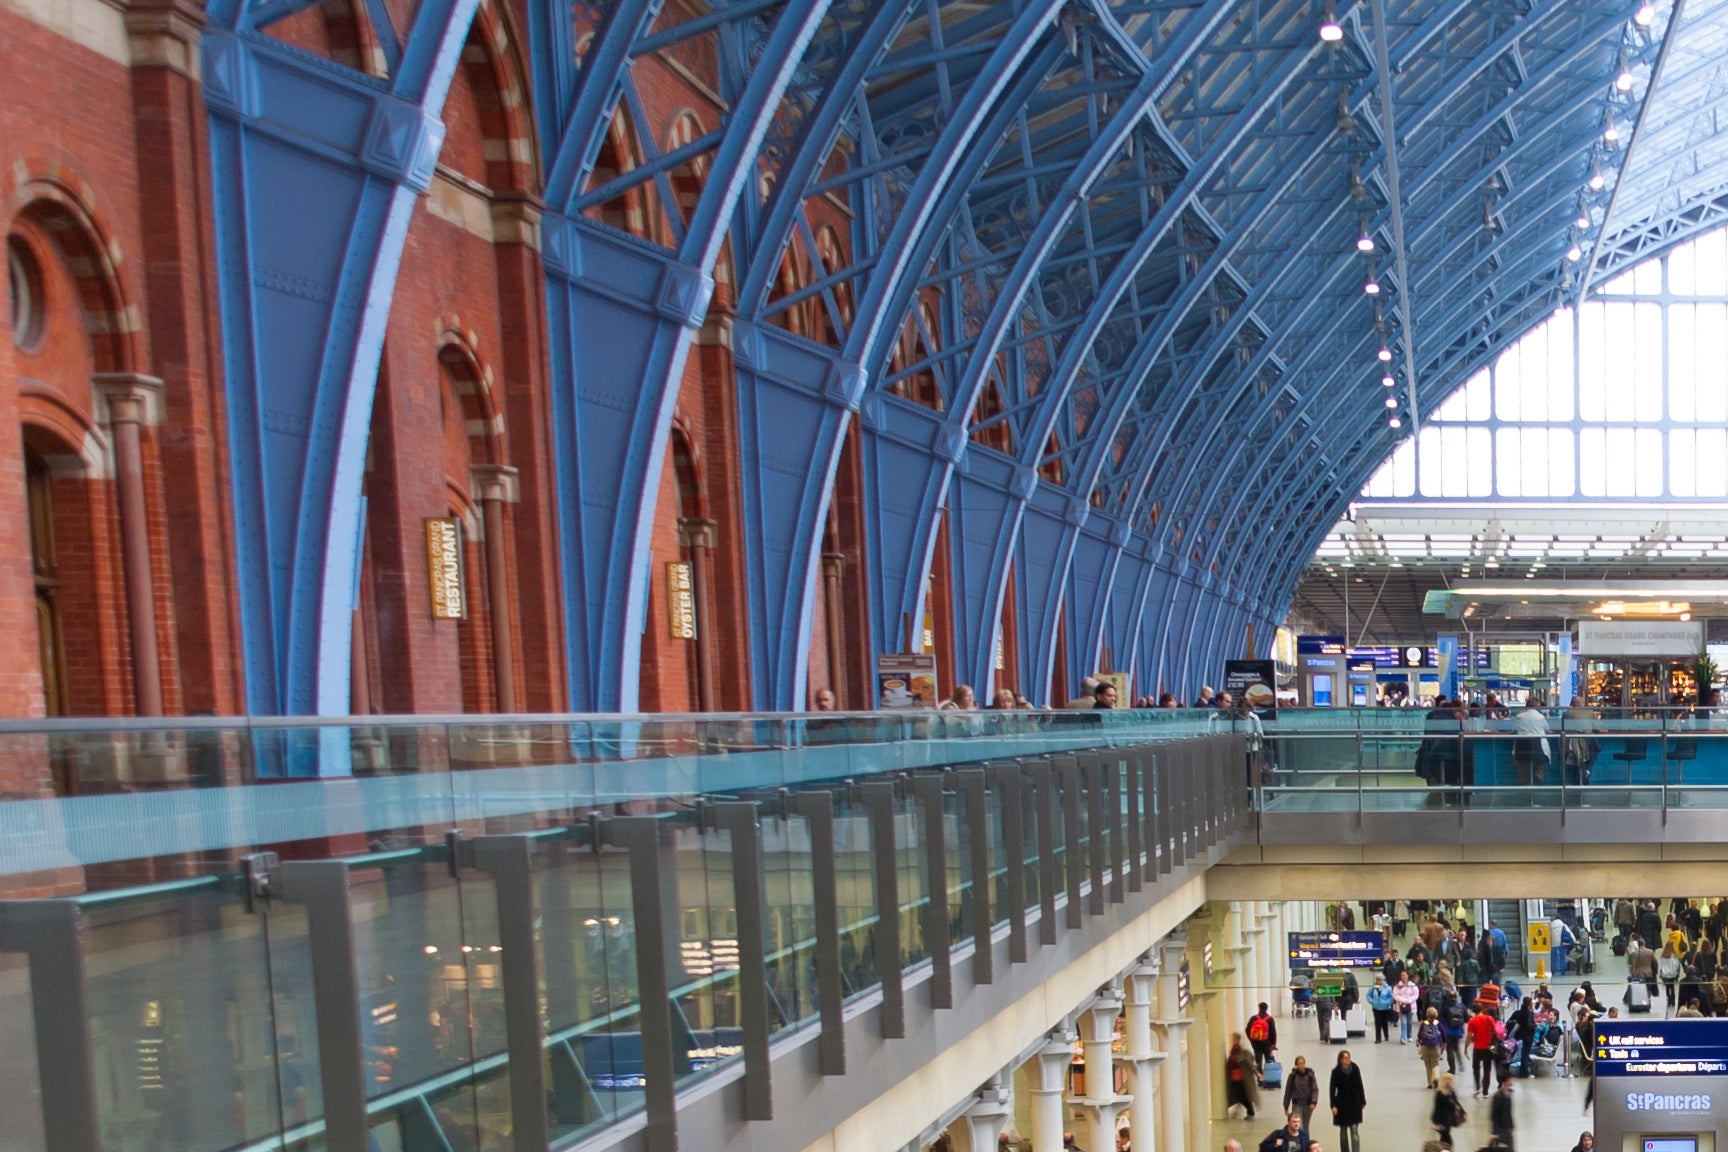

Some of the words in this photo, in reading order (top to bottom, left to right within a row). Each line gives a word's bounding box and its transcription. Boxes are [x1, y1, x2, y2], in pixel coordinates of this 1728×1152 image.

[430, 521, 442, 557] GRAND
[432, 558, 447, 603] PANCRAS
[440, 522, 461, 618] RESTAURANT
[677, 564, 691, 589] BAR
[679, 592, 693, 638] OYSTER
[1609, 1036, 1621, 1045] UK
[1634, 1035, 1664, 1045] services
[1609, 1049, 1628, 1058] Taxis
[1626, 1063, 1657, 1072] Eurostar
[1657, 1063, 1697, 1073] departures
[1698, 1062, 1727, 1072] Départs
